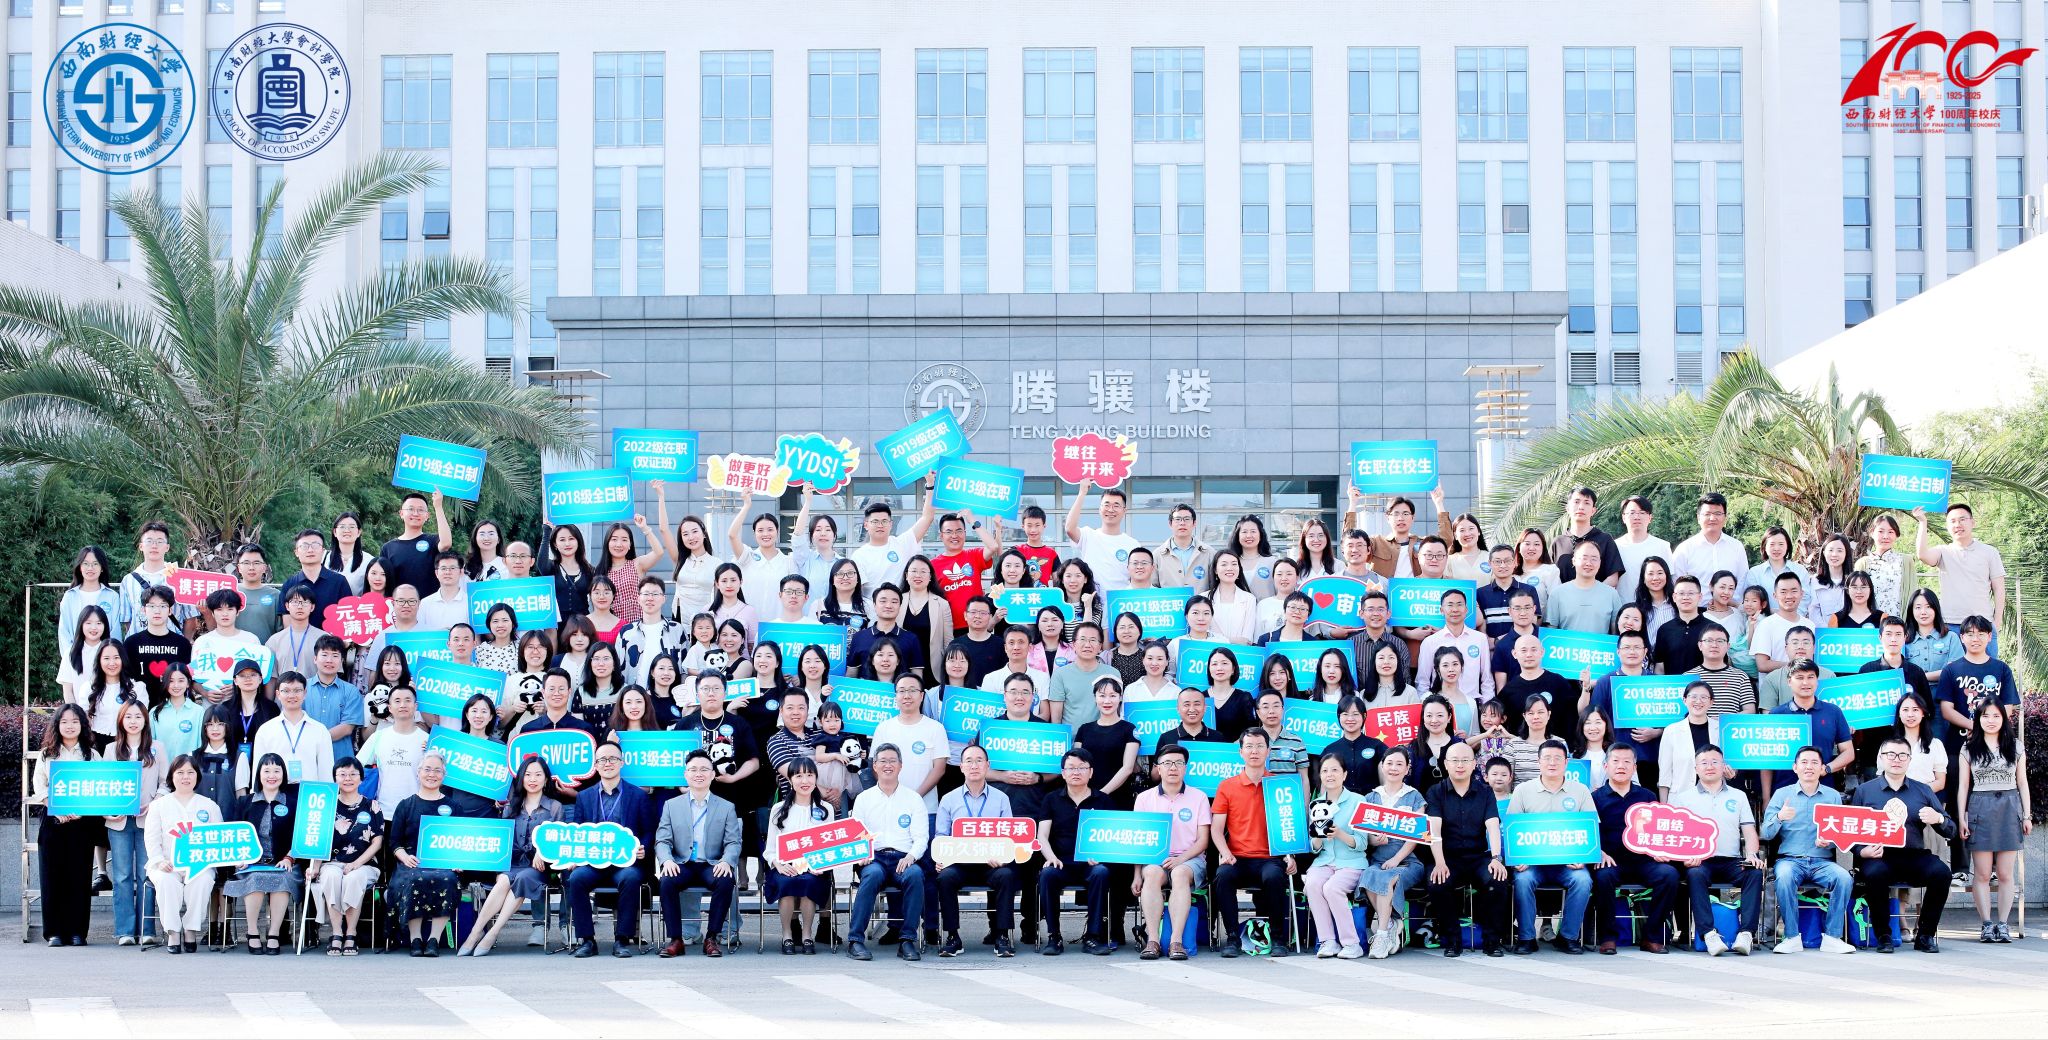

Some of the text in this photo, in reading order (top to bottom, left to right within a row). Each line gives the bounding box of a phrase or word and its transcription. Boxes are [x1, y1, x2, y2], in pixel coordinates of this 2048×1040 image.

[1011, 368, 1213, 415] 腾骧楼
[889, 423, 950, 459] 2019级在职
[1010, 425, 1211, 439] TENG XIANG BUILDING
[623, 440, 688, 455] 2022级在职
[906, 440, 948, 469] (双证班)
[1063, 445, 1096, 460] 继往
[401, 453, 479, 483] 2019级全日制
[632, 456, 676, 470] (双证班)
[728, 459, 770, 477] 做更好
[784, 445, 837, 479] YYDS!
[1082, 461, 1114, 477] 开来
[1358, 458, 1432, 475] 在职在校生
[726, 473, 769, 491] 的我们
[945, 476, 1011, 501] 2013级在职
[1866, 472, 1945, 494] 2014级全日制
[551, 485, 629, 506] 2018级全日制
[1010, 593, 1042, 605] 未来
[1399, 589, 1441, 600] 2014级
[335, 603, 376, 621] 元气
[473, 595, 551, 615] 201级全日制
[1119, 600, 1184, 612] 2021级在职
[343, 618, 383, 636] 满满
[1549, 645, 1615, 667] 2015级在职
[1821, 643, 1884, 657] 2021级全日
[198, 651, 217, 671] 我
[1635, 702, 1681, 715] (双证班)
[1377, 710, 1409, 727] 民族
[1285, 717, 1343, 739] 2016级全
[1731, 728, 1800, 741] 2015级在职
[541, 741, 589, 765] SWUFE
[985, 736, 1066, 756] 2009级全日制
[1742, 743, 1790, 757] (双证班)
[54, 779, 136, 797] 全日制在校生
[961, 821, 1029, 837] 百年传承
[1361, 808, 1417, 834] 奥利给
[1656, 818, 1684, 832] 团结
[1822, 815, 1898, 838] 大显身手
[188, 828, 251, 845] 经世济民
[429, 834, 501, 853] 2006级在职
[545, 828, 616, 845] 确认过眼神
[786, 827, 849, 852] 服务 交流
[1088, 828, 1159, 847] 2004级在职
[1516, 830, 1588, 847] 2007级在职
[1637, 832, 1706, 850] 就是生产力
[189, 846, 252, 863] 孜孜以求
[559, 845, 629, 861] 同是会计人
